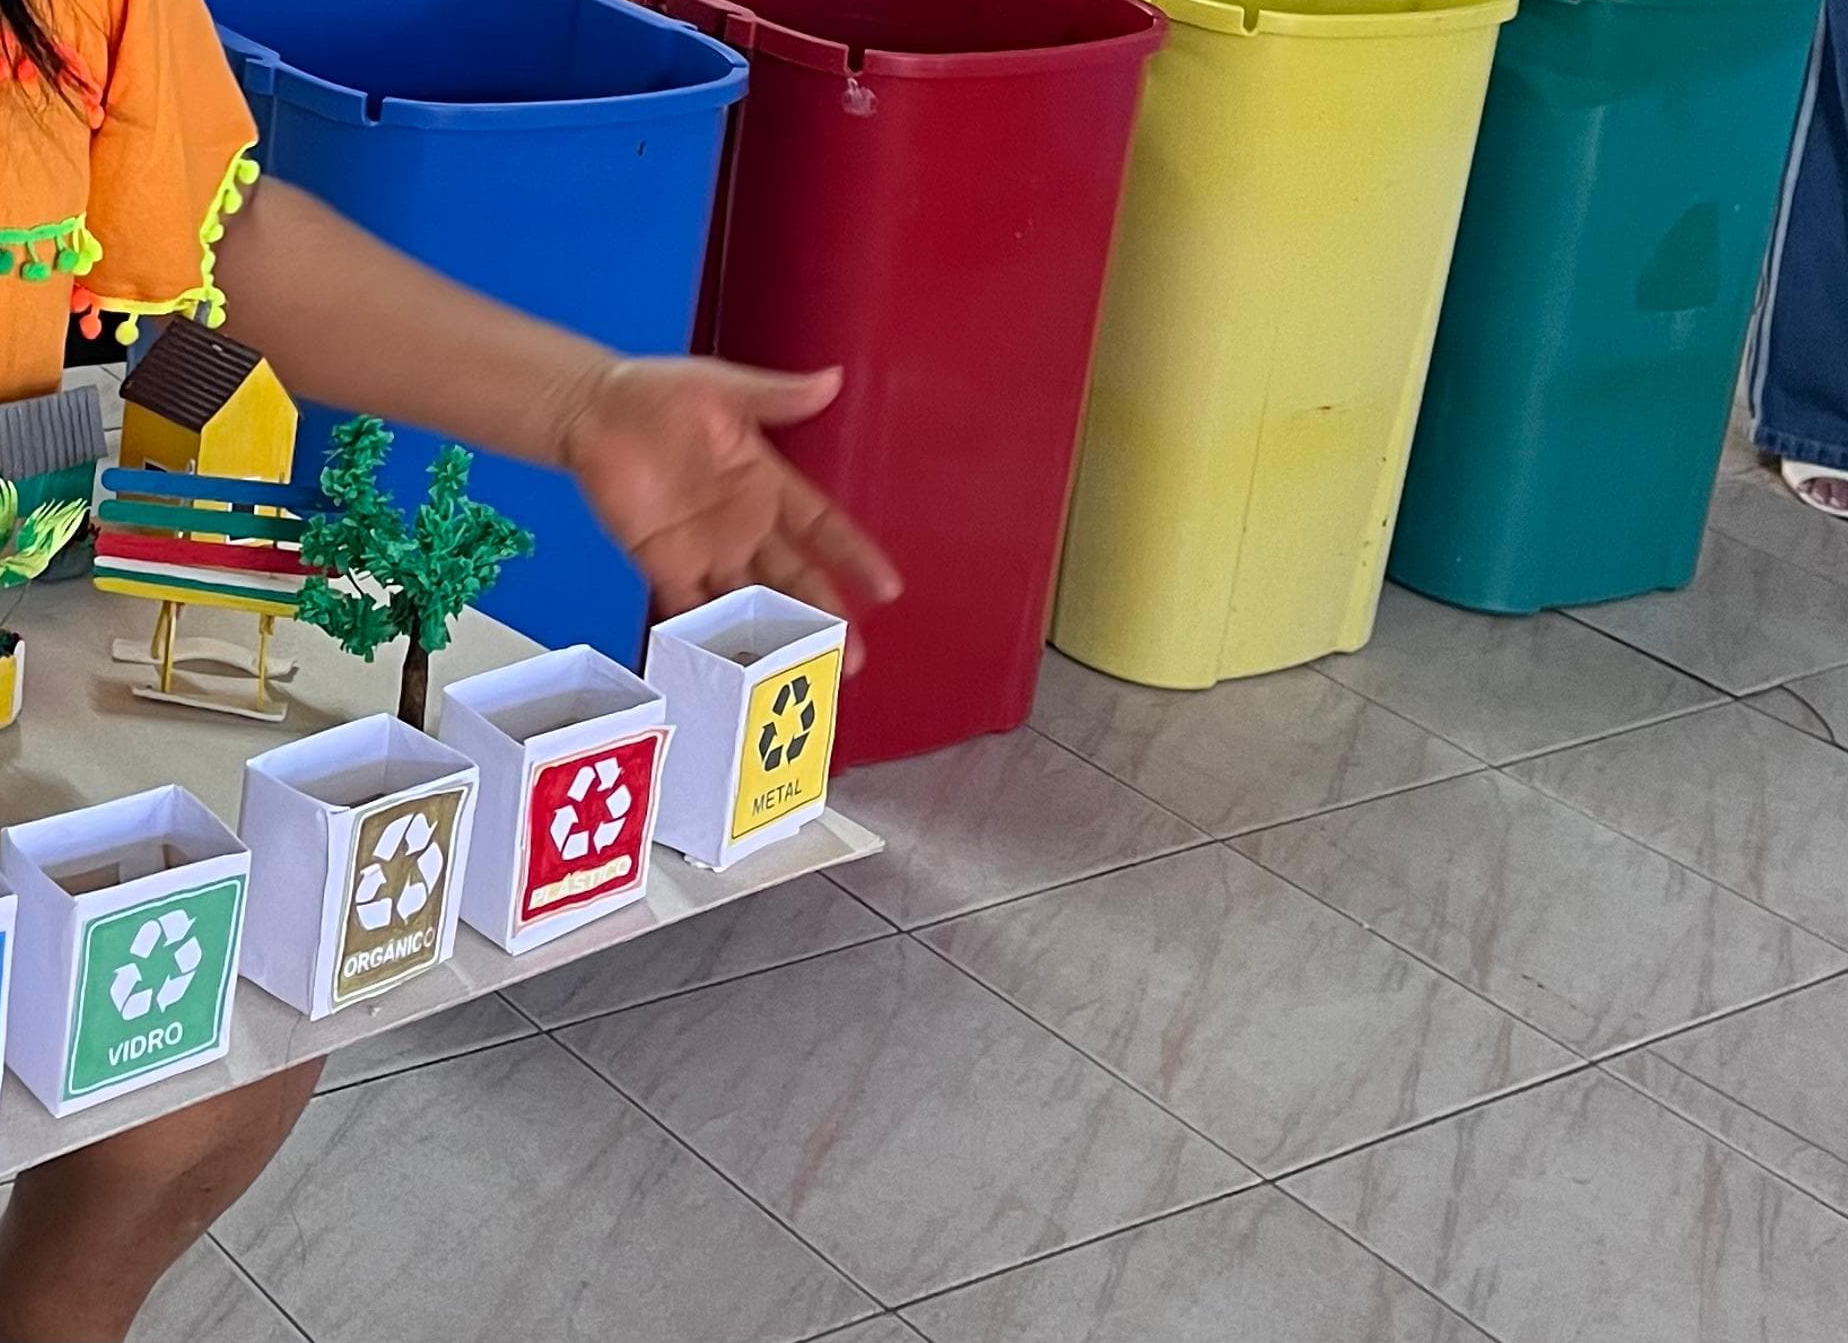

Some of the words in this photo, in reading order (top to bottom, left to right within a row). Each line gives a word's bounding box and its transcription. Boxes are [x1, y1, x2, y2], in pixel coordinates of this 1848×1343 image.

[752, 782, 802, 816] METAL
[532, 854, 632, 905] PLÁSTICO
[108, 1021, 184, 1066] VIDRO
